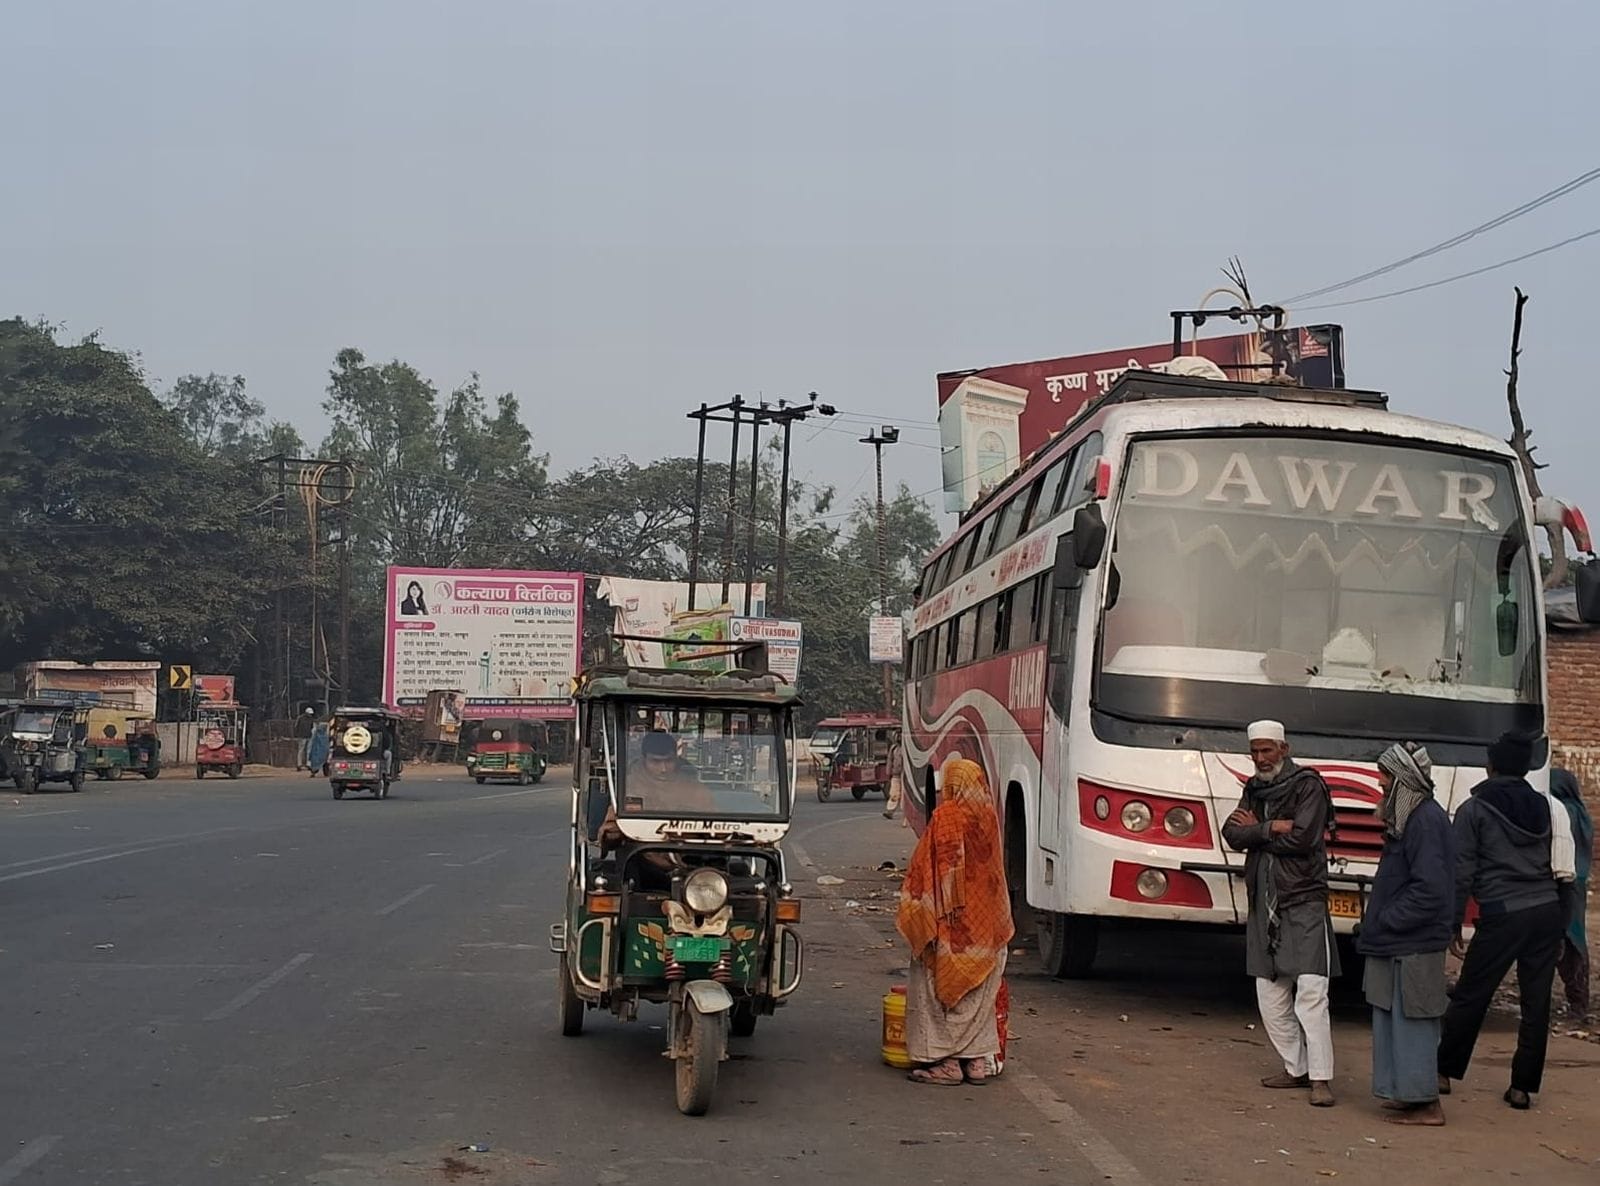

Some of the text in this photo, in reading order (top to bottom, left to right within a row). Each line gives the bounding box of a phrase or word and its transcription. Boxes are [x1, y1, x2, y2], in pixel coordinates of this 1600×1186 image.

[1044, 372, 1088, 402] कृष्ण
[1138, 446, 1500, 531] DAWAR
[457, 584, 573, 601] कल्याण क्लिनिक
[450, 604, 480, 615] आरती
[483, 606, 509, 616] यादव
[669, 819, 742, 831] Mini Metro
